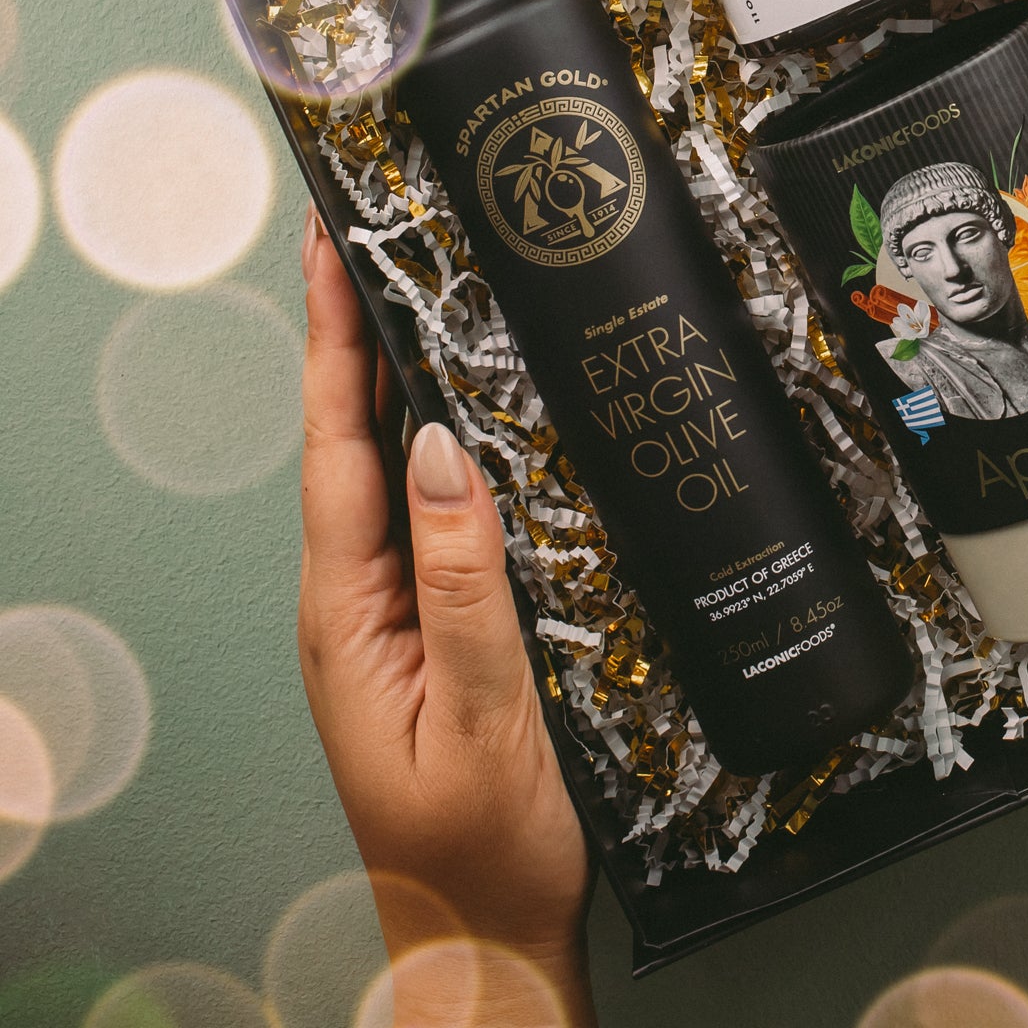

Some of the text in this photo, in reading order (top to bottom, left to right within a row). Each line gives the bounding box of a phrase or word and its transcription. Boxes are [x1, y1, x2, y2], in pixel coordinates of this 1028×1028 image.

[456, 77, 534, 157] SPARTAN
[832, 103, 960, 174] LACONICFOODS
[547, 203, 616, 242] SINCE 1914
[584, 294, 669, 340] Single Estate
[581, 314, 708, 395] EXTRA
[590, 348, 737, 440] VIRGIN
[631, 399, 747, 478] OLIVE
[677, 458, 749, 512] OIL
[693, 541, 814, 610] PRODUCT OF GREECE
[709, 541, 785, 582] Cold Extraction
[807, 562, 815, 573] E
[719, 595, 845, 666] 250ml / 8.45oz
